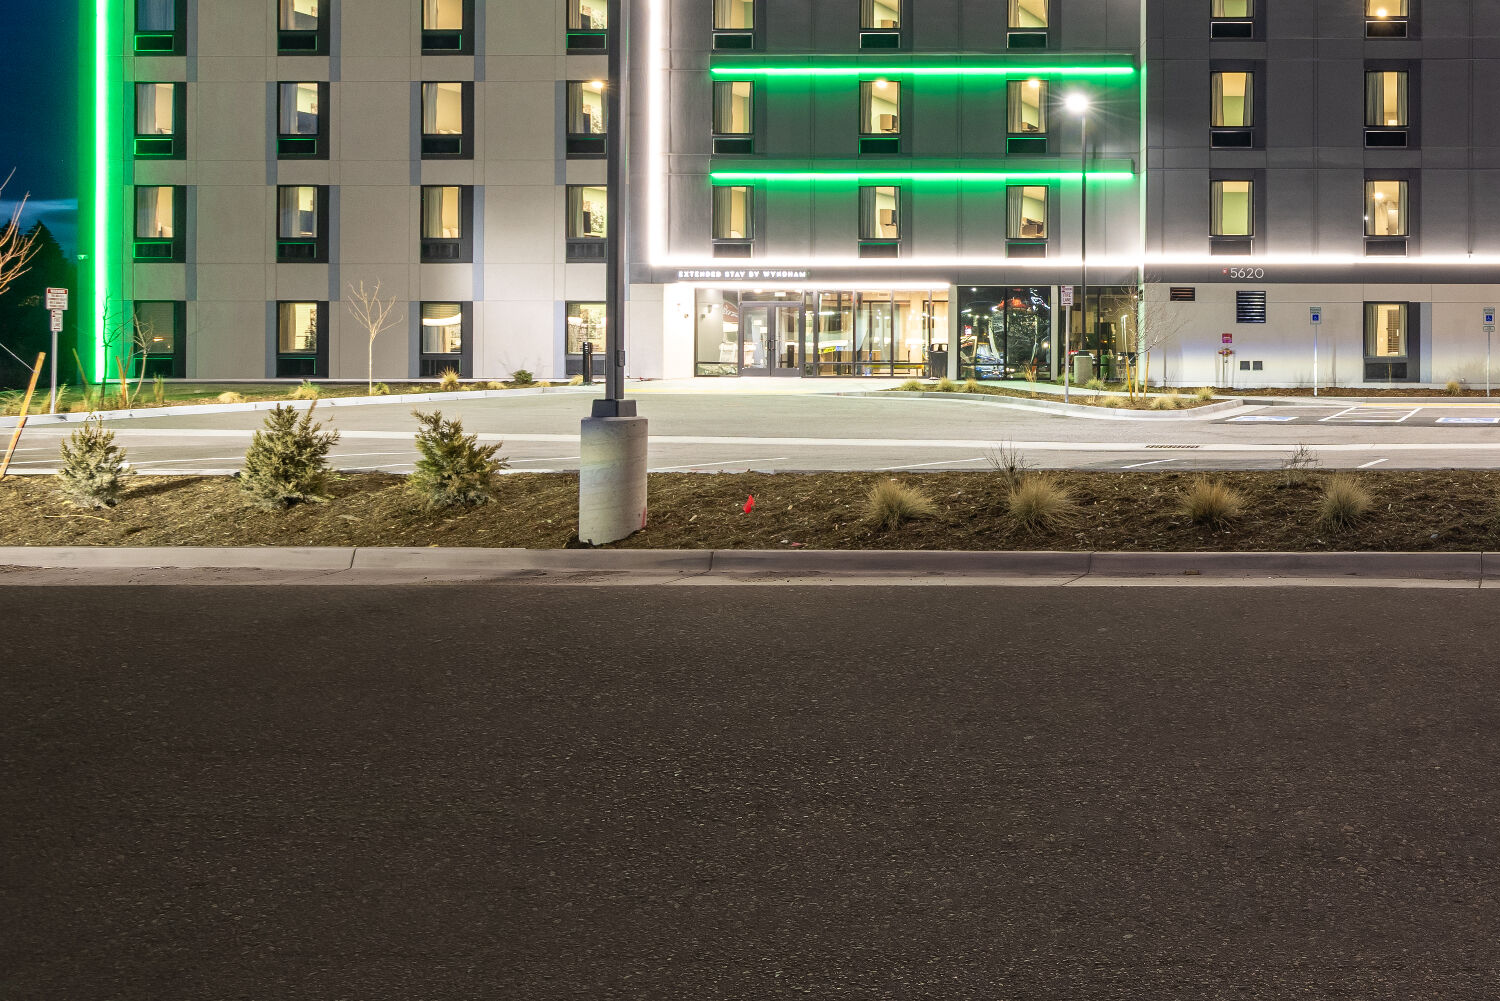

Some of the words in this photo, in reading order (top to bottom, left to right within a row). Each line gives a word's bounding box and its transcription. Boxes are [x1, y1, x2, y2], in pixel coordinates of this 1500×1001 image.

[678, 270, 722, 278] EXTENDED
[724, 270, 745, 278] STAY
[748, 270, 760, 278] BY
[763, 270, 806, 278] WYNDHAM
[1230, 267, 1265, 279] 5620
